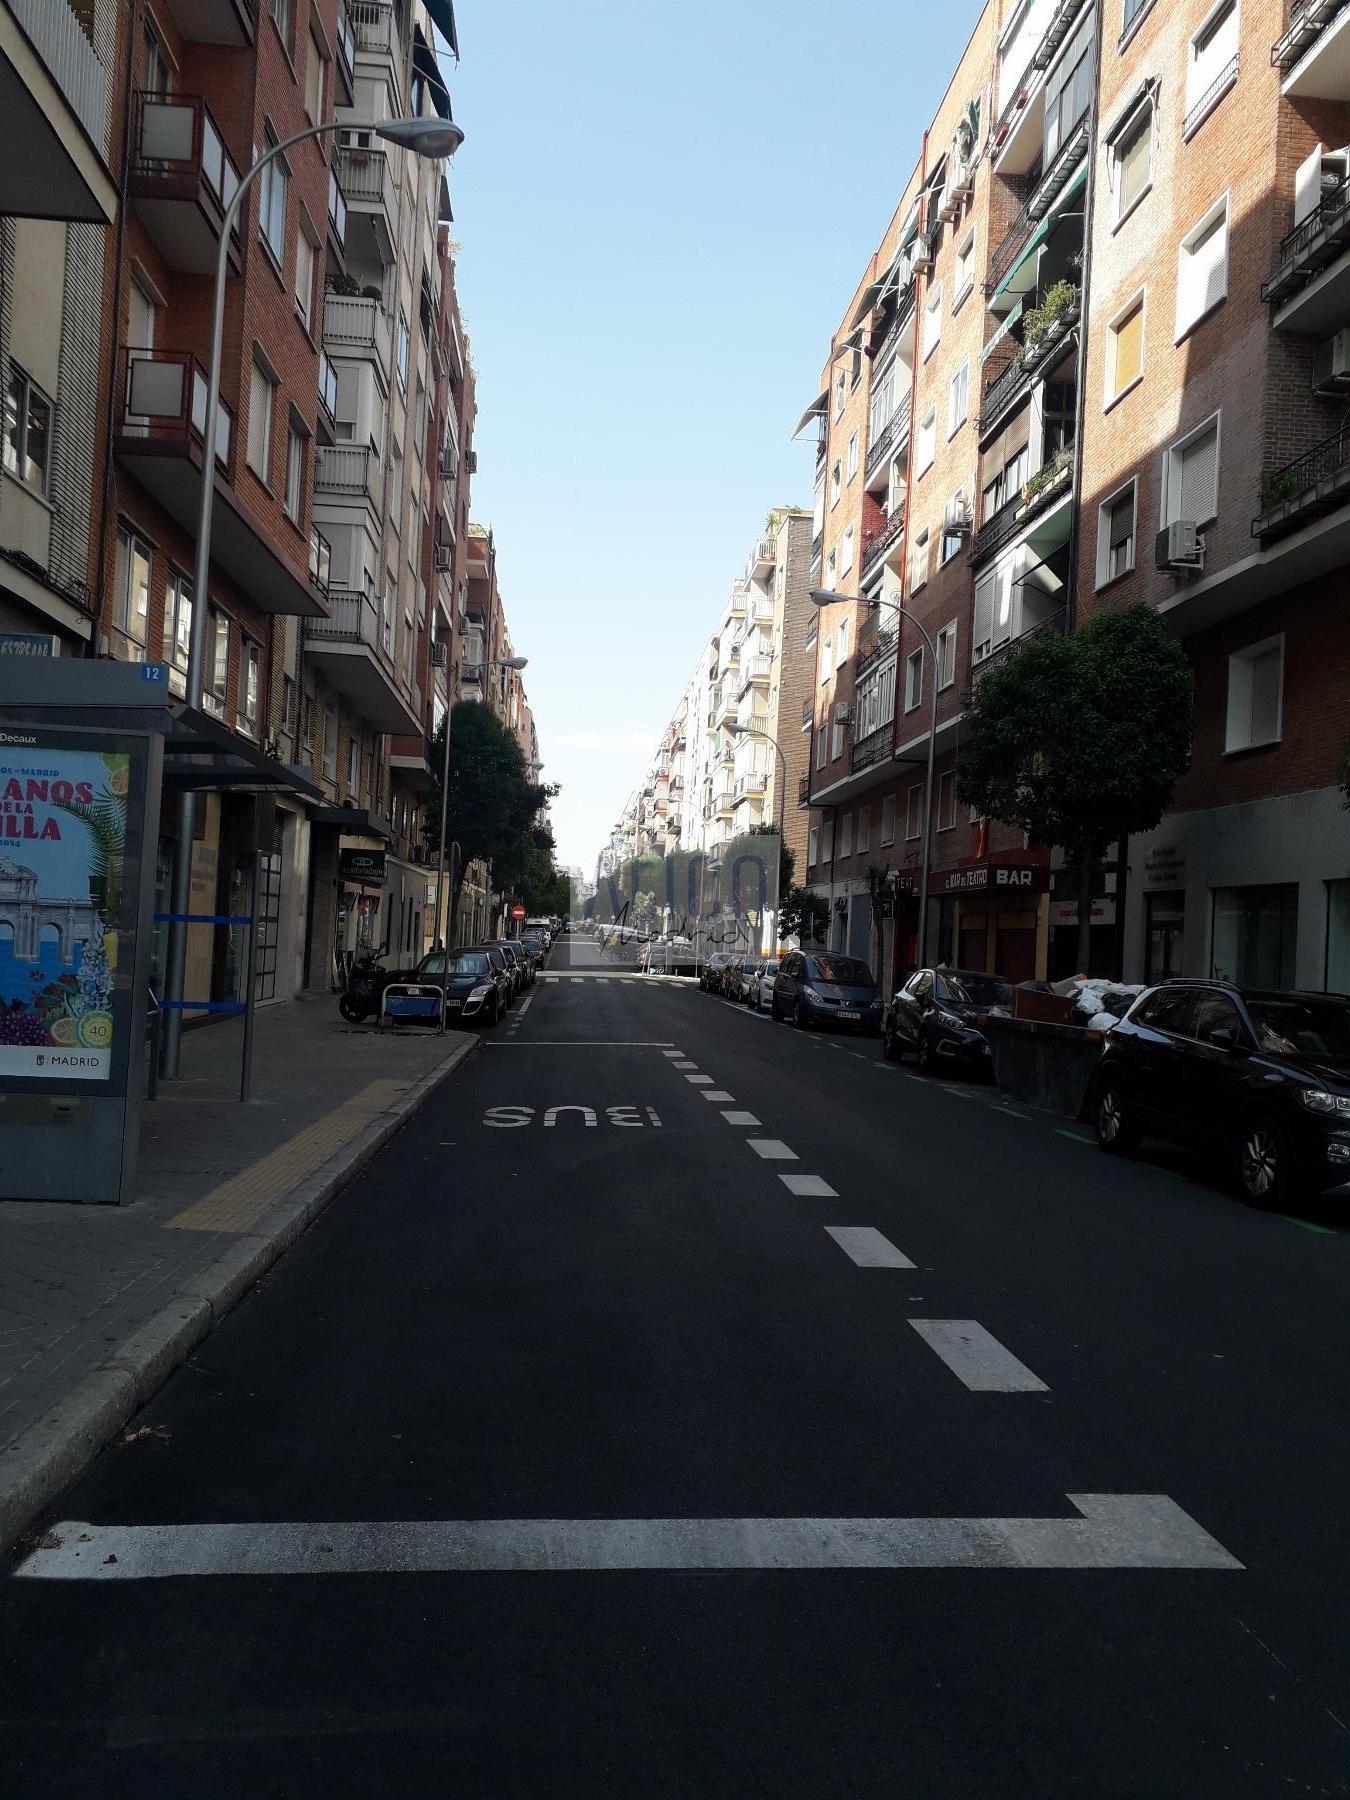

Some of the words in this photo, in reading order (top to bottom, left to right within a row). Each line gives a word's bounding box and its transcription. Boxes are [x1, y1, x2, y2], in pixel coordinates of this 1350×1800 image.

[145, 667, 160, 679] 12
[0, 733, 37, 743] Decaux
[21, 768, 60, 777] MADRID
[15, 802, 34, 814] LA
[996, 869, 1032, 885] BAR
[90, 1025, 106, 1037] 40
[51, 1056, 99, 1067] MADRID
[482, 1105, 662, 1128] BUS
